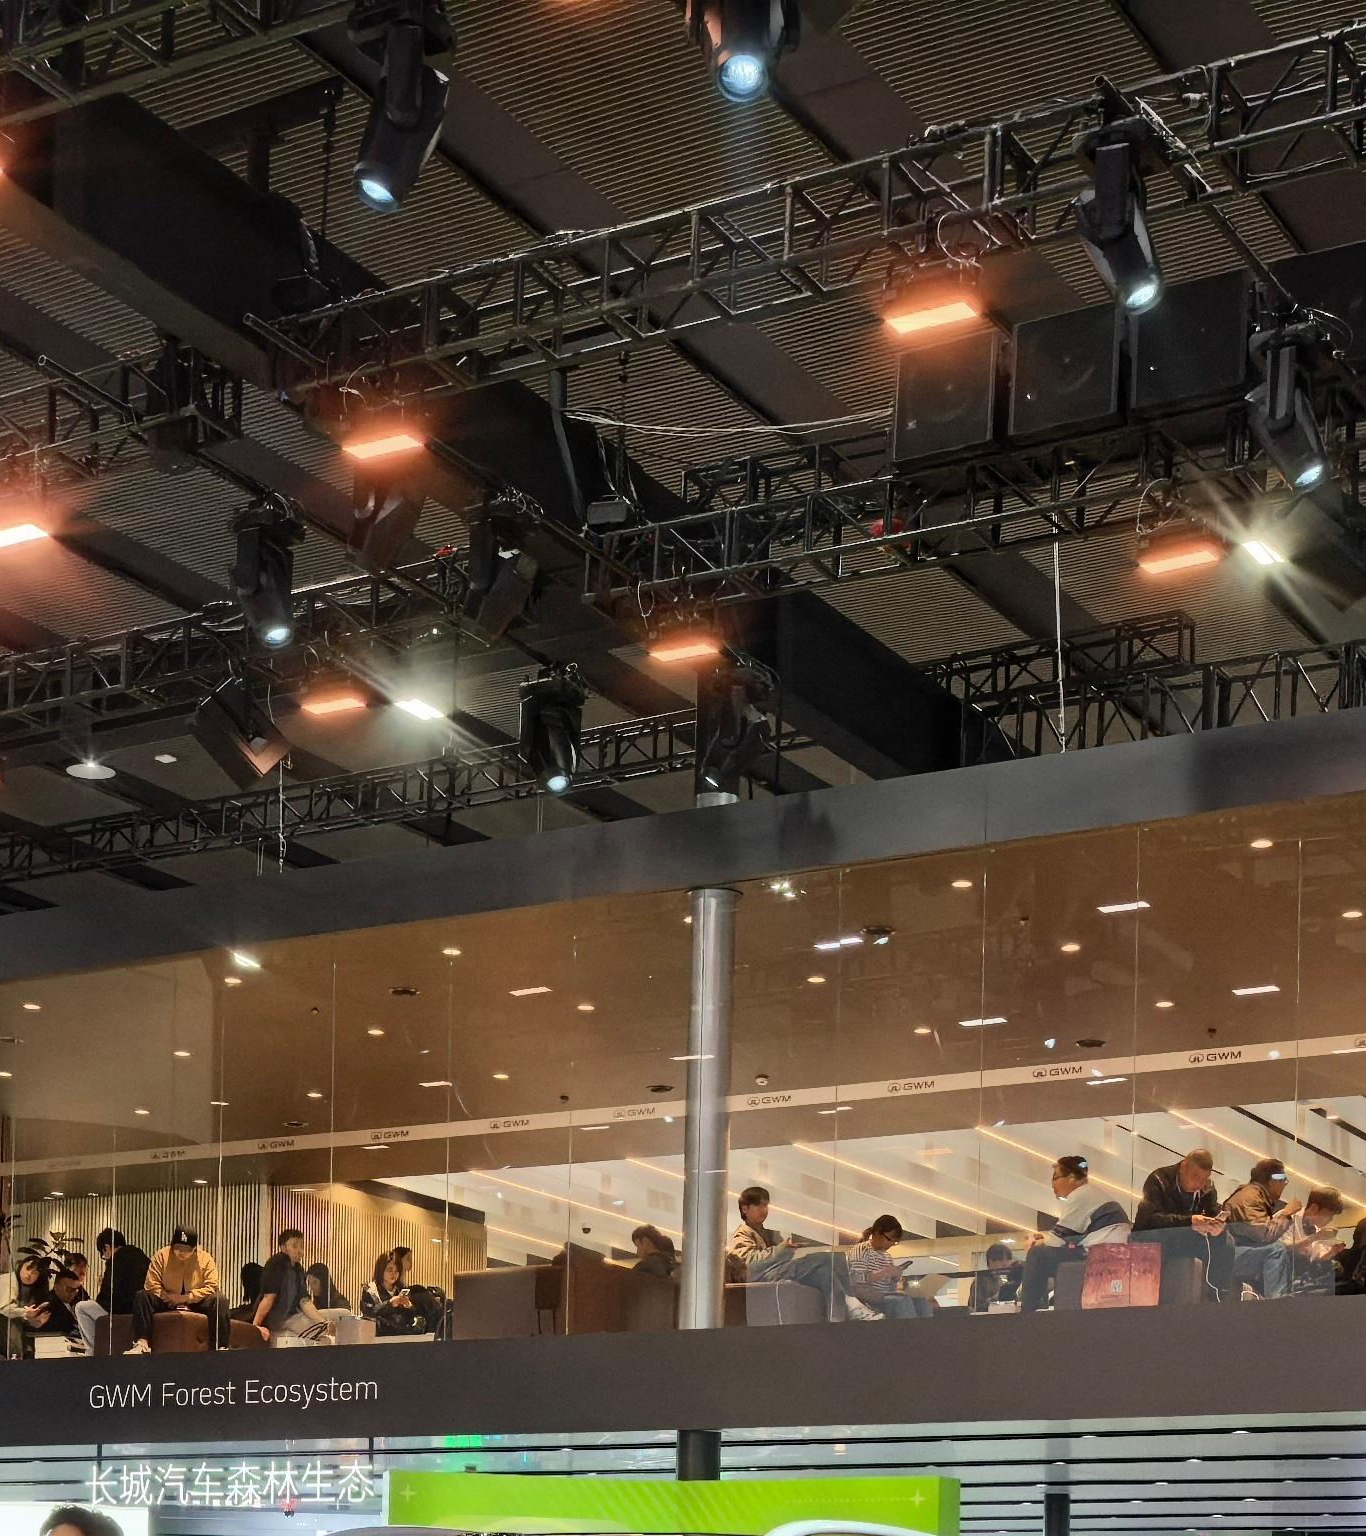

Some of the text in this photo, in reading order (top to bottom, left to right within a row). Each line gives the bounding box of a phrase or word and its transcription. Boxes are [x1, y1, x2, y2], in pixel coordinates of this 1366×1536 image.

[1207, 1050, 1243, 1062] GWM
[1048, 1065, 1083, 1077] GWM
[903, 1080, 935, 1092] GWM
[761, 1095, 792, 1105] GWM
[627, 1107, 656, 1116] GWM
[89, 1376, 379, 1410] GWM Forest Ecosystem
[85, 1459, 375, 1507] 长城汽车森林生态
